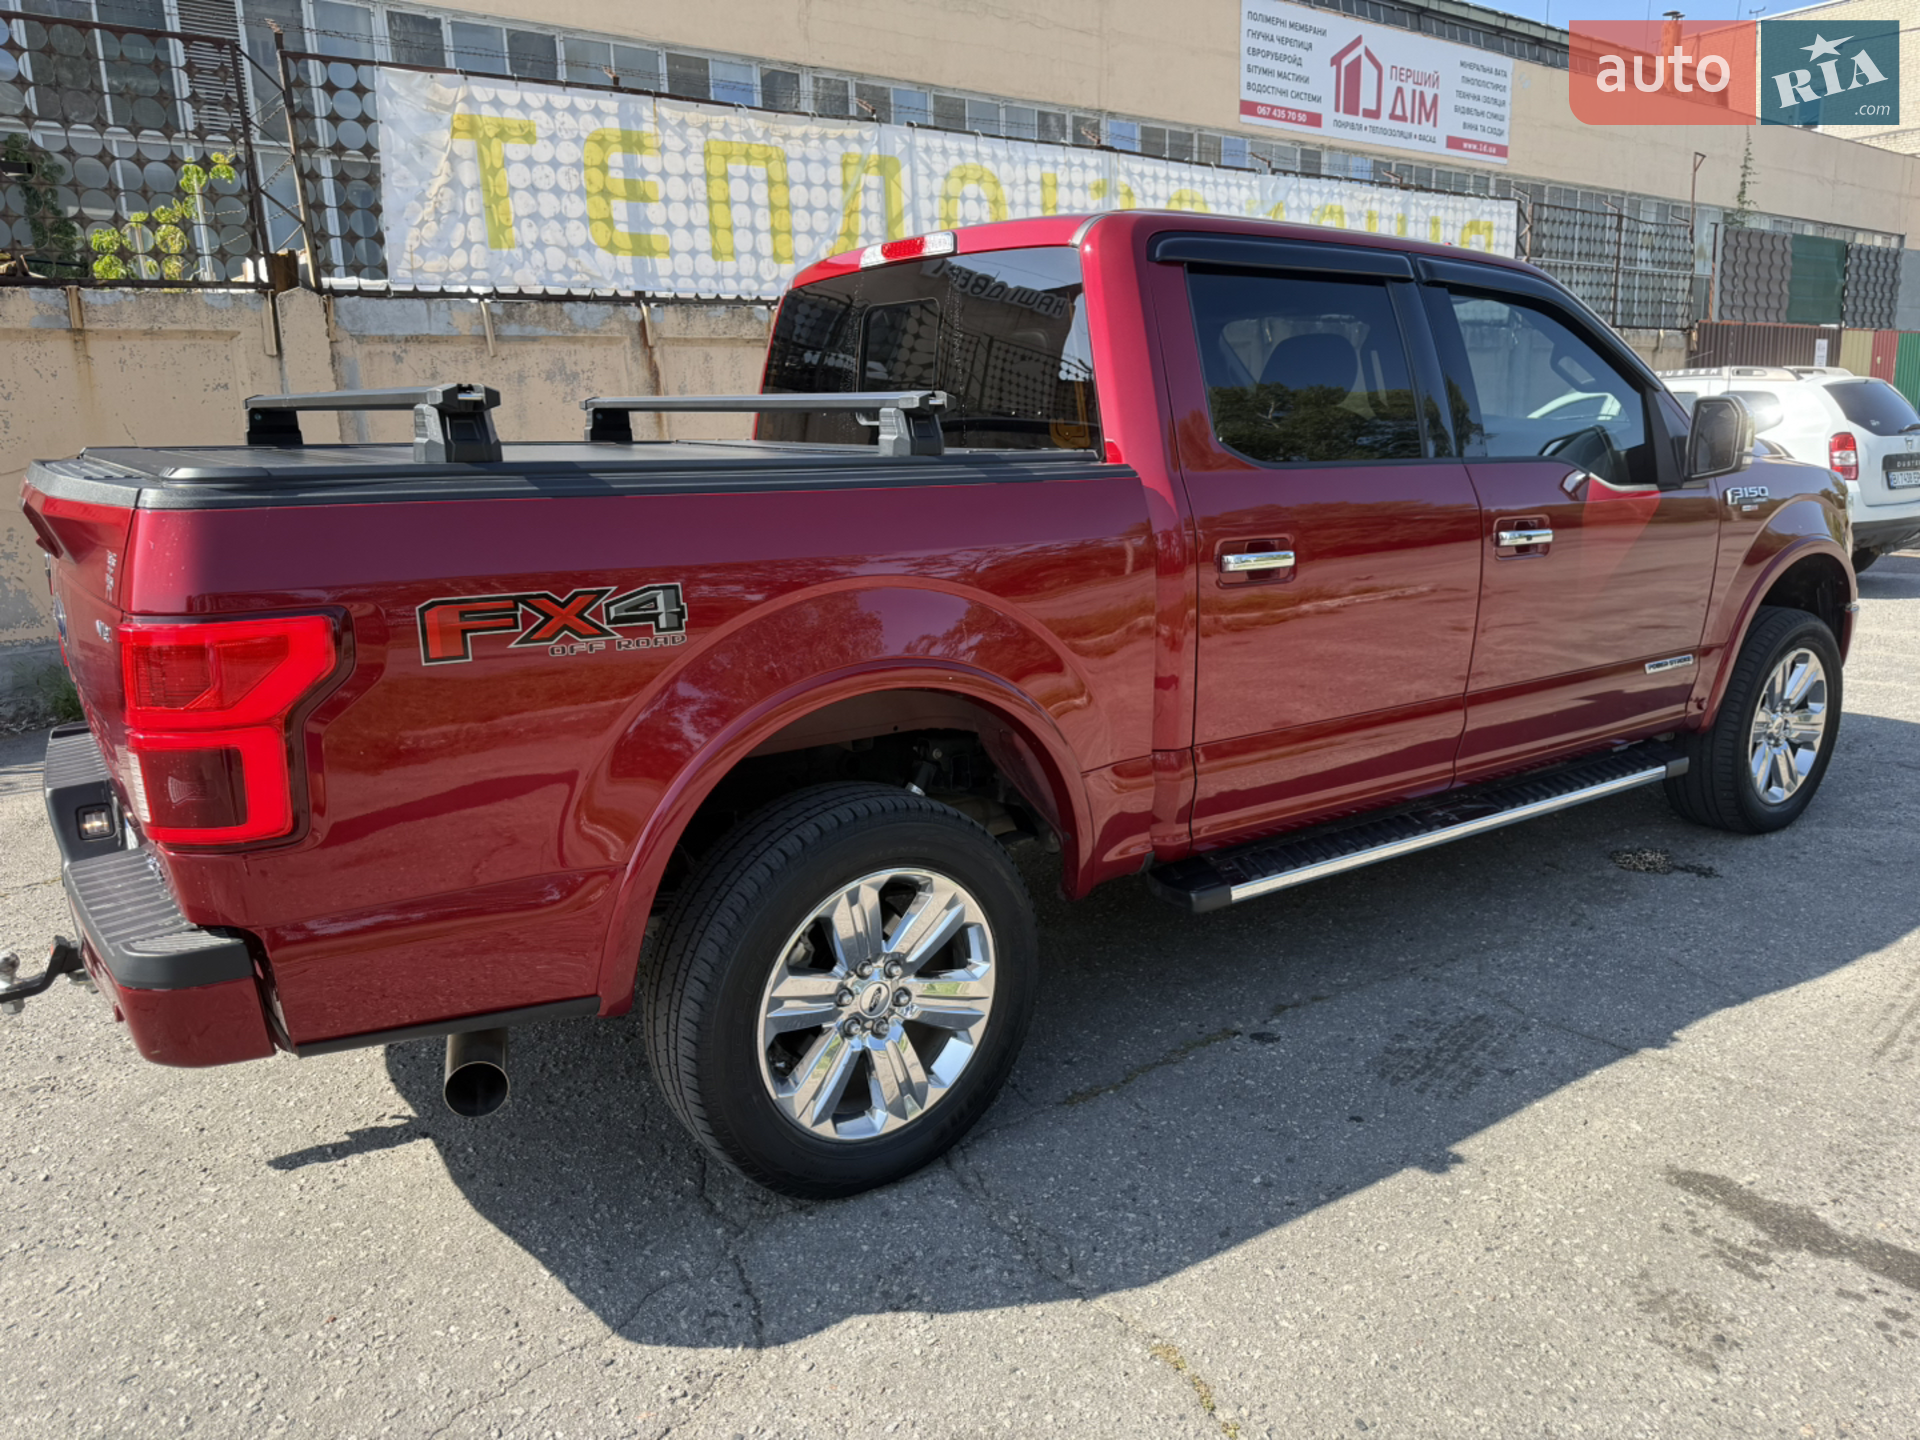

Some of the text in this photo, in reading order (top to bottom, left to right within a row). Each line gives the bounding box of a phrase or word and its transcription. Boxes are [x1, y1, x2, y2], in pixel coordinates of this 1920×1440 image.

[1247, 11, 1327, 37] ПОЛІМЕРНІ МЕМБРАНИ
[1247, 29, 1313, 51] ГНУЧКА ЧЕРЕПИЦЯ
[1247, 46, 1303, 67] ЄВРОРУБЕРОЙД
[1247, 64, 1275, 78] БІТУМНІ
[1390, 65, 1440, 90] ПЕРШИЙ
[1246, 82, 1322, 104] ВОДОСТІЧНІ СИСТЕМИ
[1257, 106, 1307, 122] 067 435 70 50
[1389, 86, 1439, 128] ДІМ
[415, 582, 688, 666] FX4
[549, 634, 687, 657] OFF ROAD
